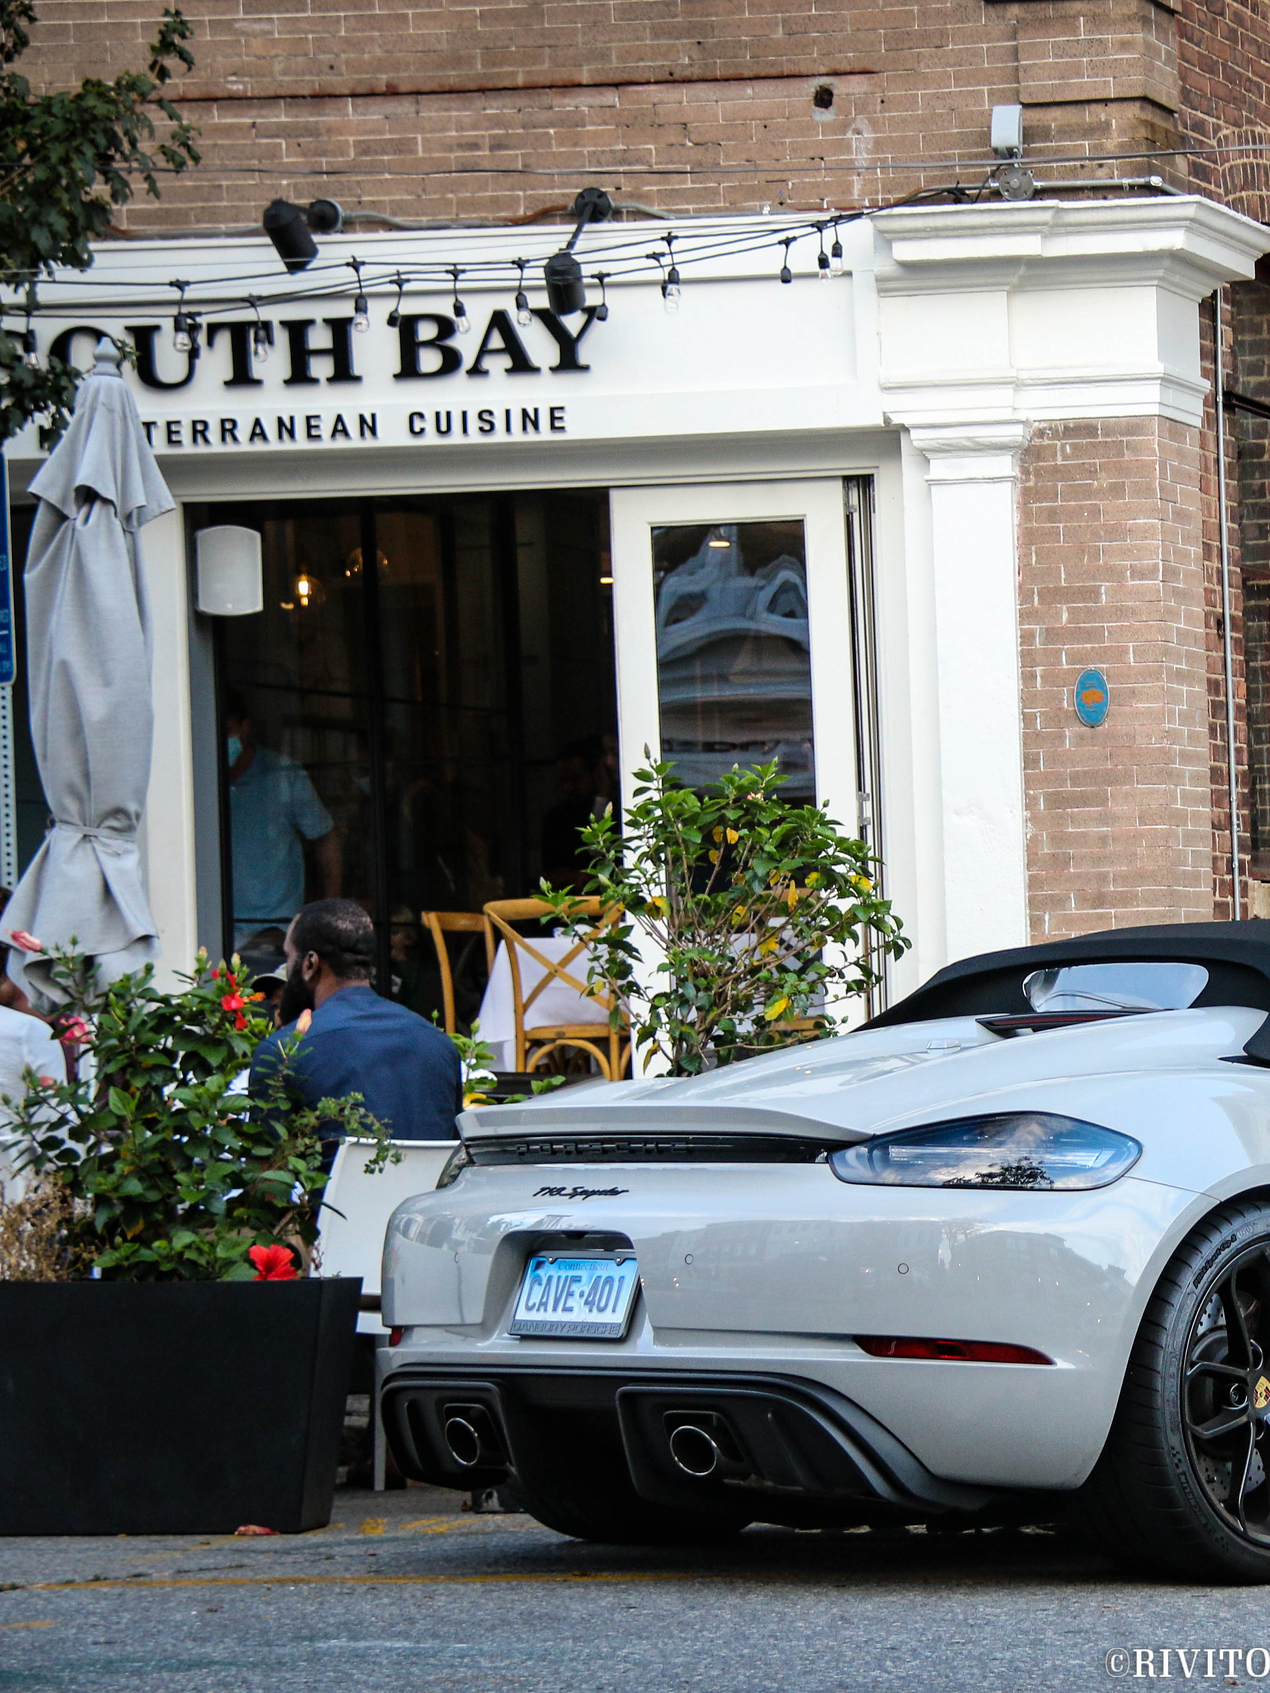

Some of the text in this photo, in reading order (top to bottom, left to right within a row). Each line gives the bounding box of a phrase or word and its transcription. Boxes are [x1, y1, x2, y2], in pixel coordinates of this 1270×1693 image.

[0, 305, 601, 389] OUTH BAY
[39, 405, 567, 449] TERRANEAN CUISINE
[516, 1141, 688, 1155] PORSCHE
[558, 1260, 609, 1271] Connecticut
[512, 1321, 566, 1334] DANBURY
